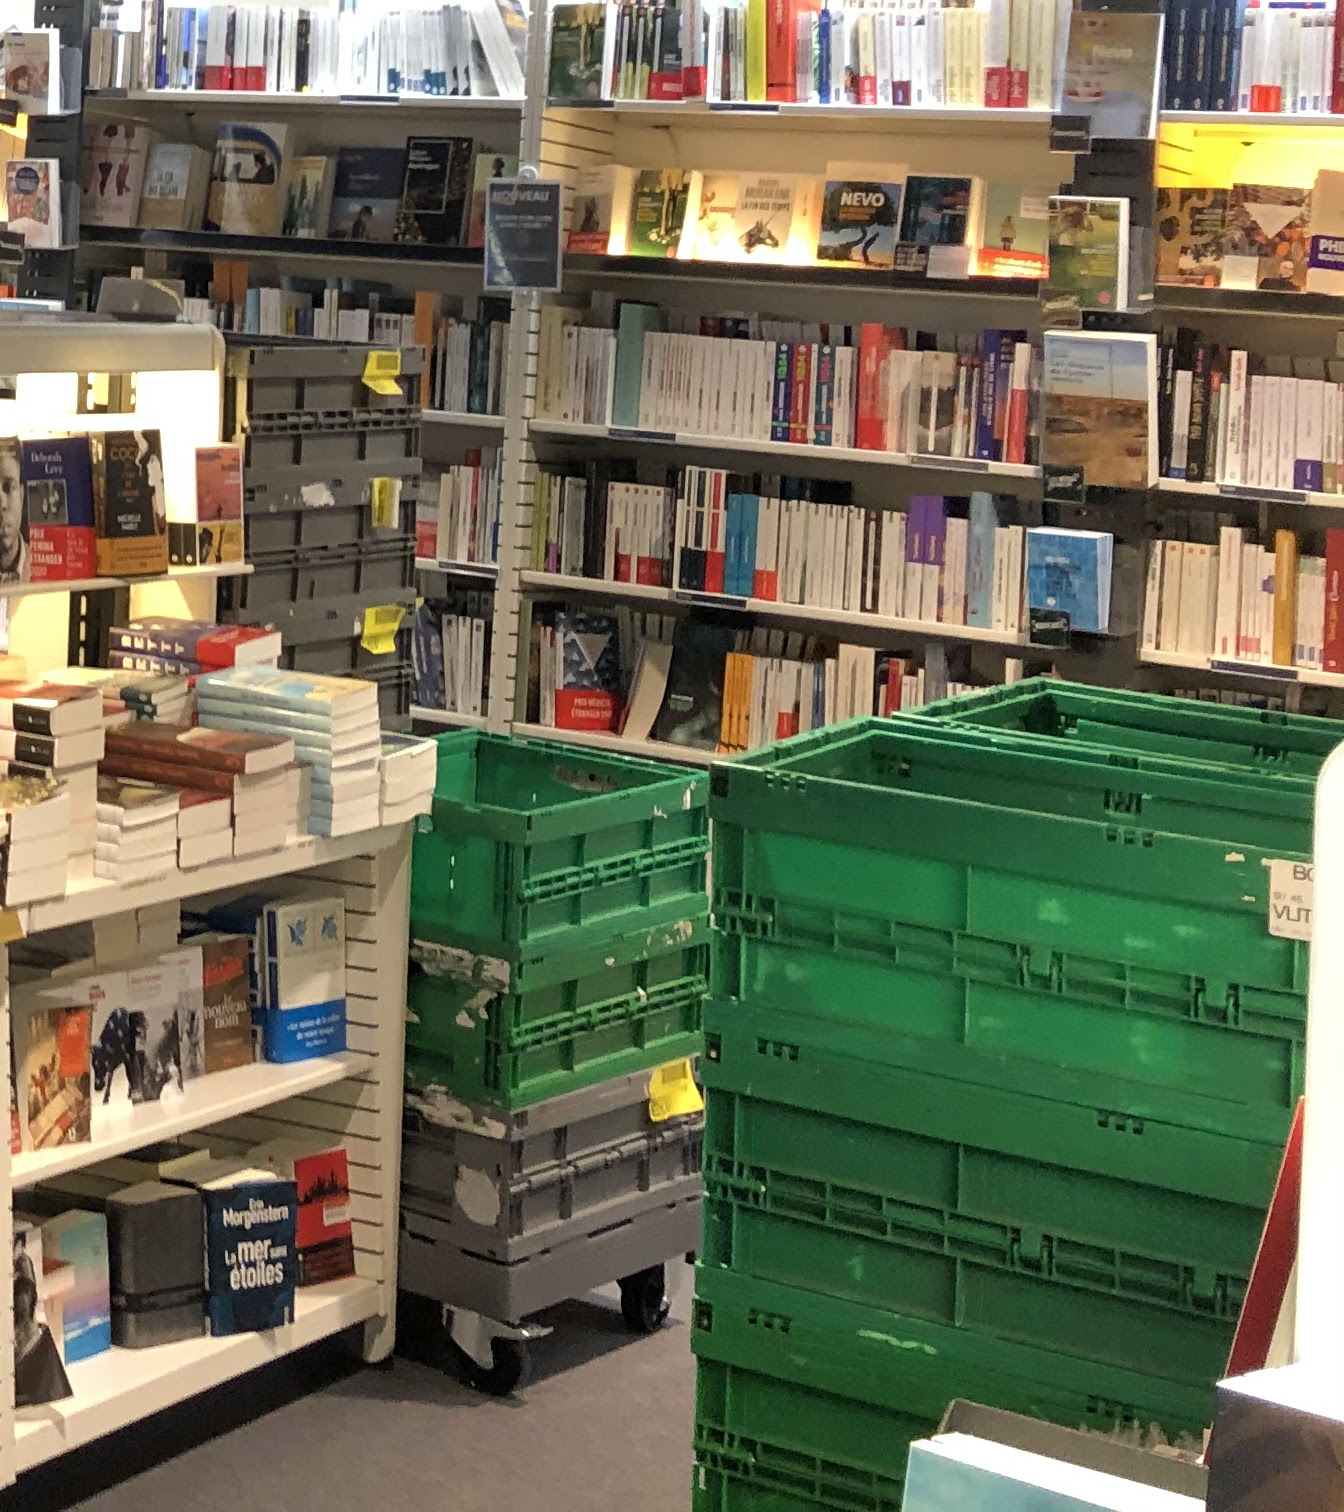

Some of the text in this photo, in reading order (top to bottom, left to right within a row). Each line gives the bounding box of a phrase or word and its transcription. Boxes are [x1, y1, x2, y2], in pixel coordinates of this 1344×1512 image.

[840, 191, 885, 208] NEVO
[222, 1205, 290, 1230] Morgenstern
[237, 1238, 272, 1262] mer
[229, 1261, 284, 1291] étoiles
